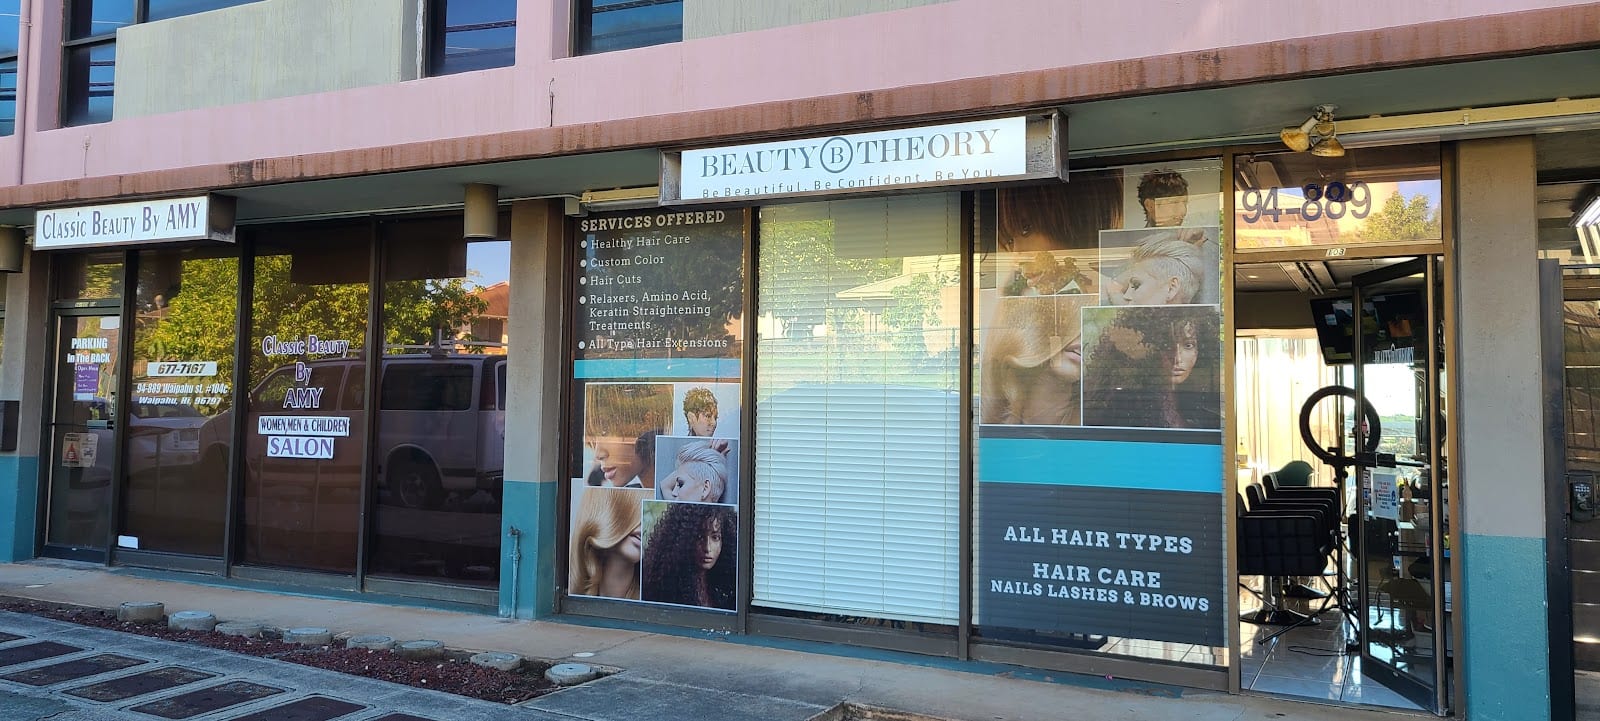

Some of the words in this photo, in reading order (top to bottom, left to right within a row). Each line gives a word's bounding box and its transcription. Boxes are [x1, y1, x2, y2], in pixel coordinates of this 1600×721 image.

[700, 145, 819, 178] BEAUTY
[856, 128, 1000, 164] THEORY
[702, 188, 719, 198] Be
[724, 181, 808, 197] Beautiful.
[814, 180, 831, 190] Be
[838, 173, 928, 189] Confident.
[935, 170, 954, 181] Be
[1242, 181, 1371, 224] 94-889
[166, 202, 201, 231] AMY
[580, 215, 652, 232] SERVICES
[655, 210, 725, 227] OFFERED
[590, 238, 633, 250] Healthy
[636, 236, 661, 247] Hair
[664, 235, 690, 245] Care
[590, 256, 631, 268] Custom
[634, 254, 665, 265] Color
[590, 275, 613, 286] Hair
[616, 274, 642, 284] Cuts
[590, 293, 639, 305] Relaxers,
[642, 291, 678, 302] Amino
[681, 290, 711, 302] Acid,
[589, 306, 629, 318] Keratin
[632, 304, 711, 317] Straightening
[589, 320, 651, 331] Treatments
[71, 337, 108, 349] PARKING
[588, 338, 604, 350] All
[606, 338, 633, 351] Type
[636, 338, 661, 348] Hair
[665, 337, 728, 348] Extensions
[67, 353, 75, 363] In
[76, 353, 90, 363] The
[91, 353, 110, 363] BACK
[158, 364, 206, 374] 677-7167
[136, 383, 162, 394] 94-889
[162, 383, 194, 395] Waipahu
[138, 396, 179, 405] Waipahu,
[194, 397, 222, 405] 96797
[282, 387, 323, 409] AMY
[304, 420, 309, 432] &
[311, 419, 347, 433] CHILDREN
[270, 437, 332, 457] SALON
[1003, 525, 1045, 543] ALL
[1051, 528, 1110, 548] HAIR
[1116, 532, 1193, 554] TYPES
[1032, 562, 1091, 583] HAIR
[1097, 567, 1161, 589] CARE
[990, 580, 1042, 596] NAILS
[1048, 584, 1118, 603] LASHES
[1123, 590, 1134, 604] &
[1139, 592, 1209, 612] BROWS
